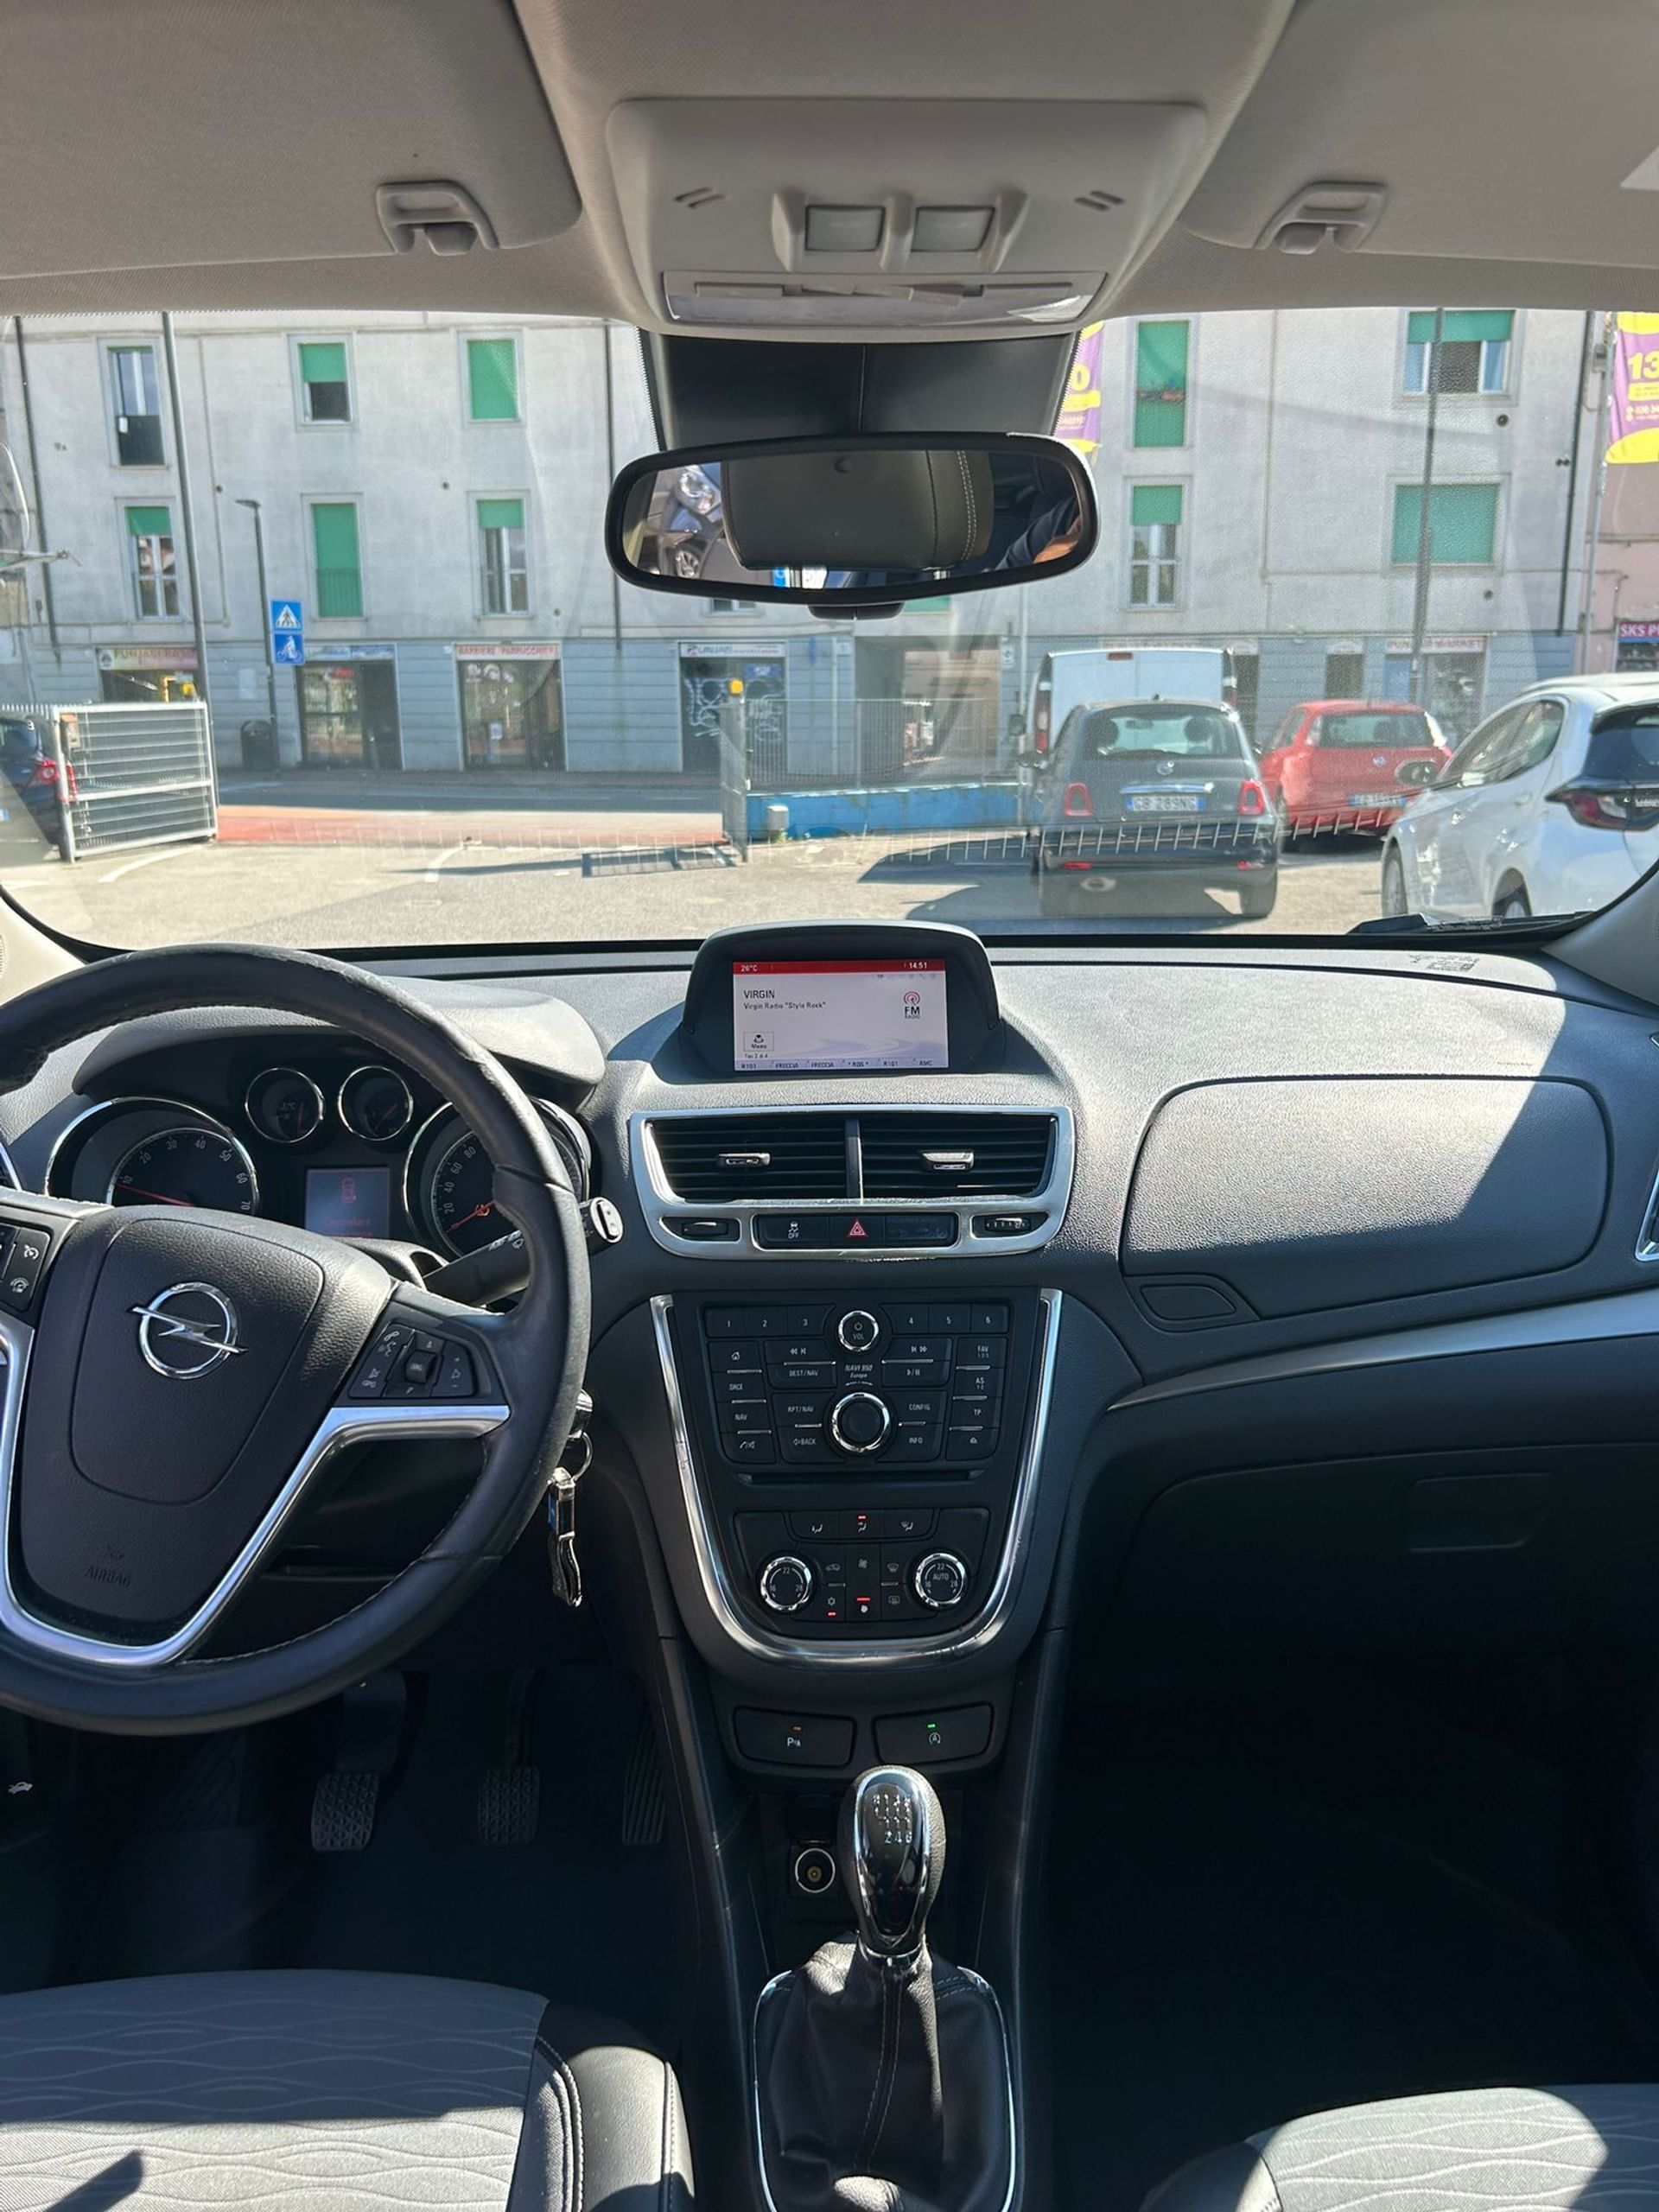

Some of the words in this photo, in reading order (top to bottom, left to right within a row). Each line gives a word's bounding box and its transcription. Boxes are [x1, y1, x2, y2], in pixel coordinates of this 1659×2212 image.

[1620, 623, 1645, 637] SKS
[743, 989, 776, 999] VIRGIN
[743, 1001, 764, 1011] Virgin
[785, 1001, 805, 1010] "Style
[806, 1001, 826, 1009] Rock"
[904, 1006, 921, 1015] FM
[166, 1140, 178, 1150] 30
[194, 1139, 207, 1149] 40
[219, 1149, 232, 1162] 50
[463, 1146, 477, 1158] 80
[139, 1152, 151, 1164] 20
[450, 1161, 463, 1174] 60
[236, 1172, 248, 1184] 60
[443, 1180, 455, 1193] 40
[443, 1202, 454, 1214] 20
[762, 1319, 768, 1328] 2
[946, 1316, 951, 1325] 5
[801, 1437, 817, 1446] BACK
